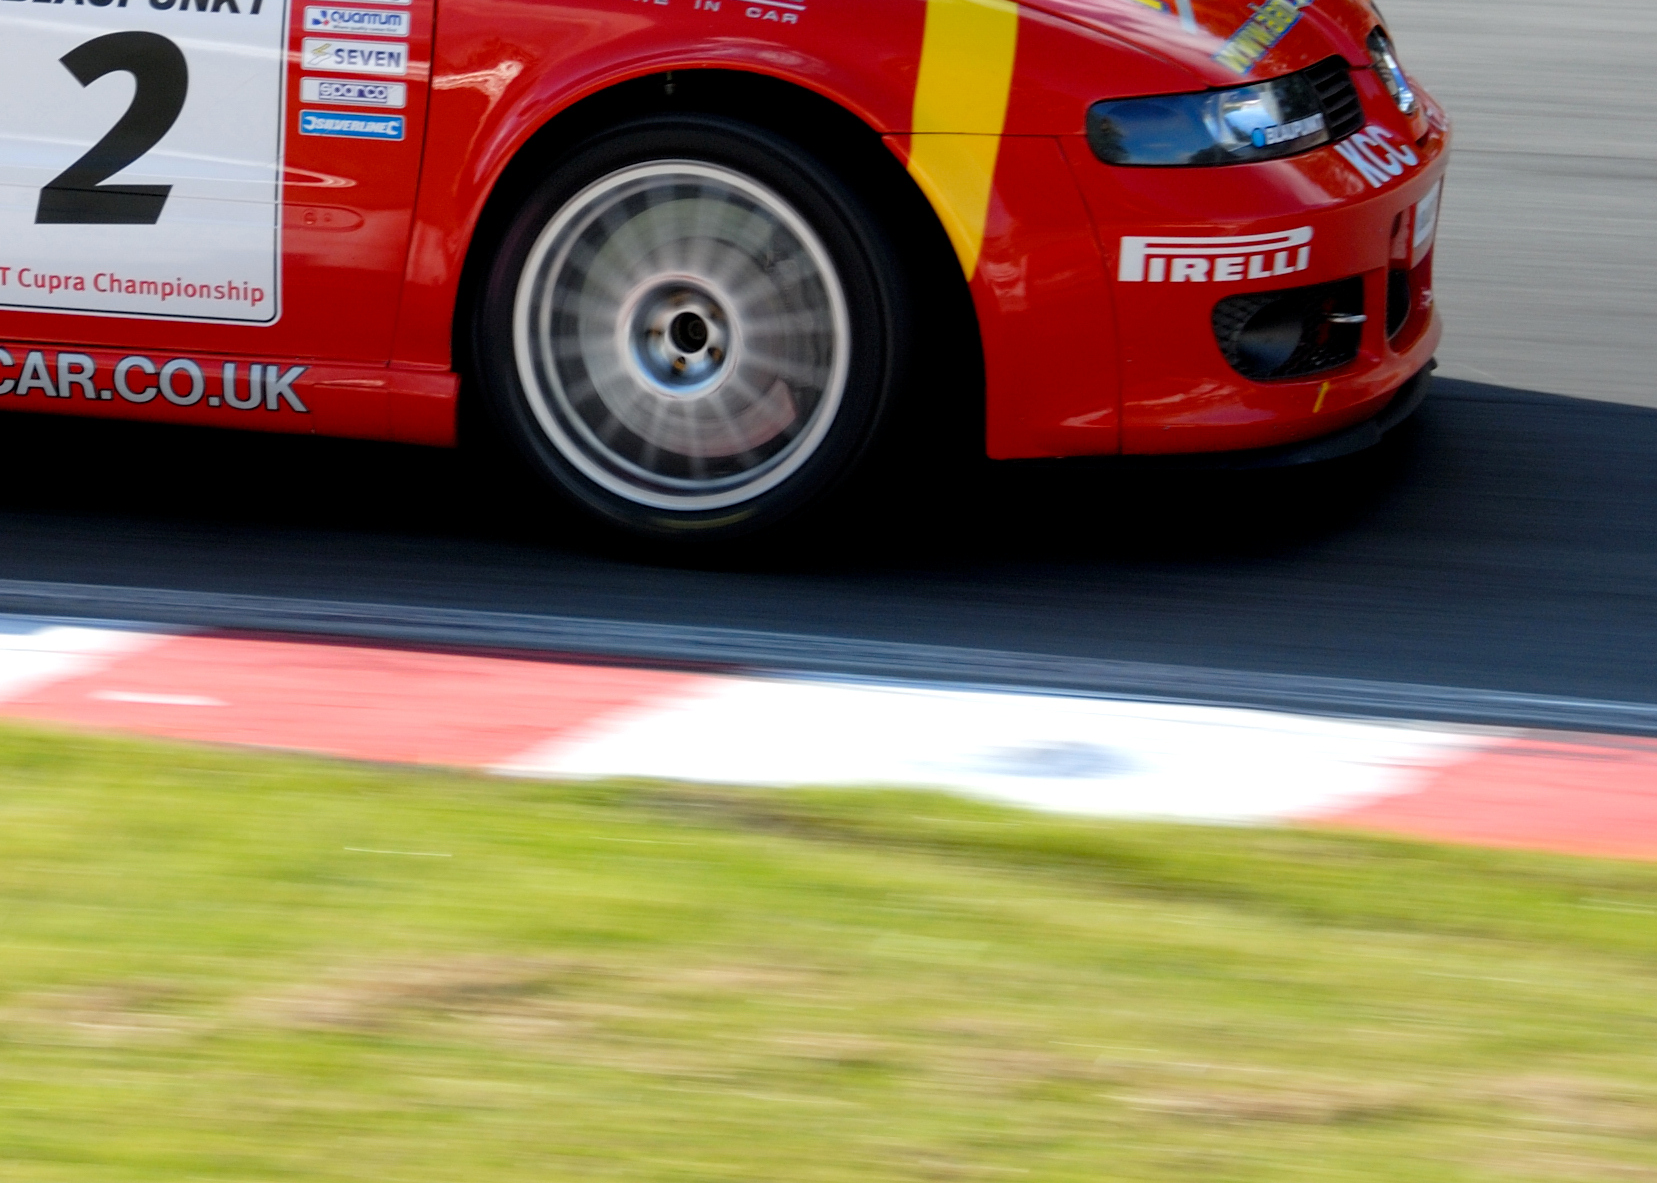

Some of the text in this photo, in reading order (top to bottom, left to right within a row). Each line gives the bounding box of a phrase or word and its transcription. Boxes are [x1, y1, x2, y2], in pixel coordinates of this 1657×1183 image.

[745, 6, 799, 24] CAR
[334, 47, 401, 68] SEVEN
[34, 30, 189, 225] 2
[315, 118, 387, 133] SILVERLINE
[1118, 225, 1314, 282] PIRELLI
[18, 267, 87, 295] Cupra
[92, 272, 265, 307] Championship
